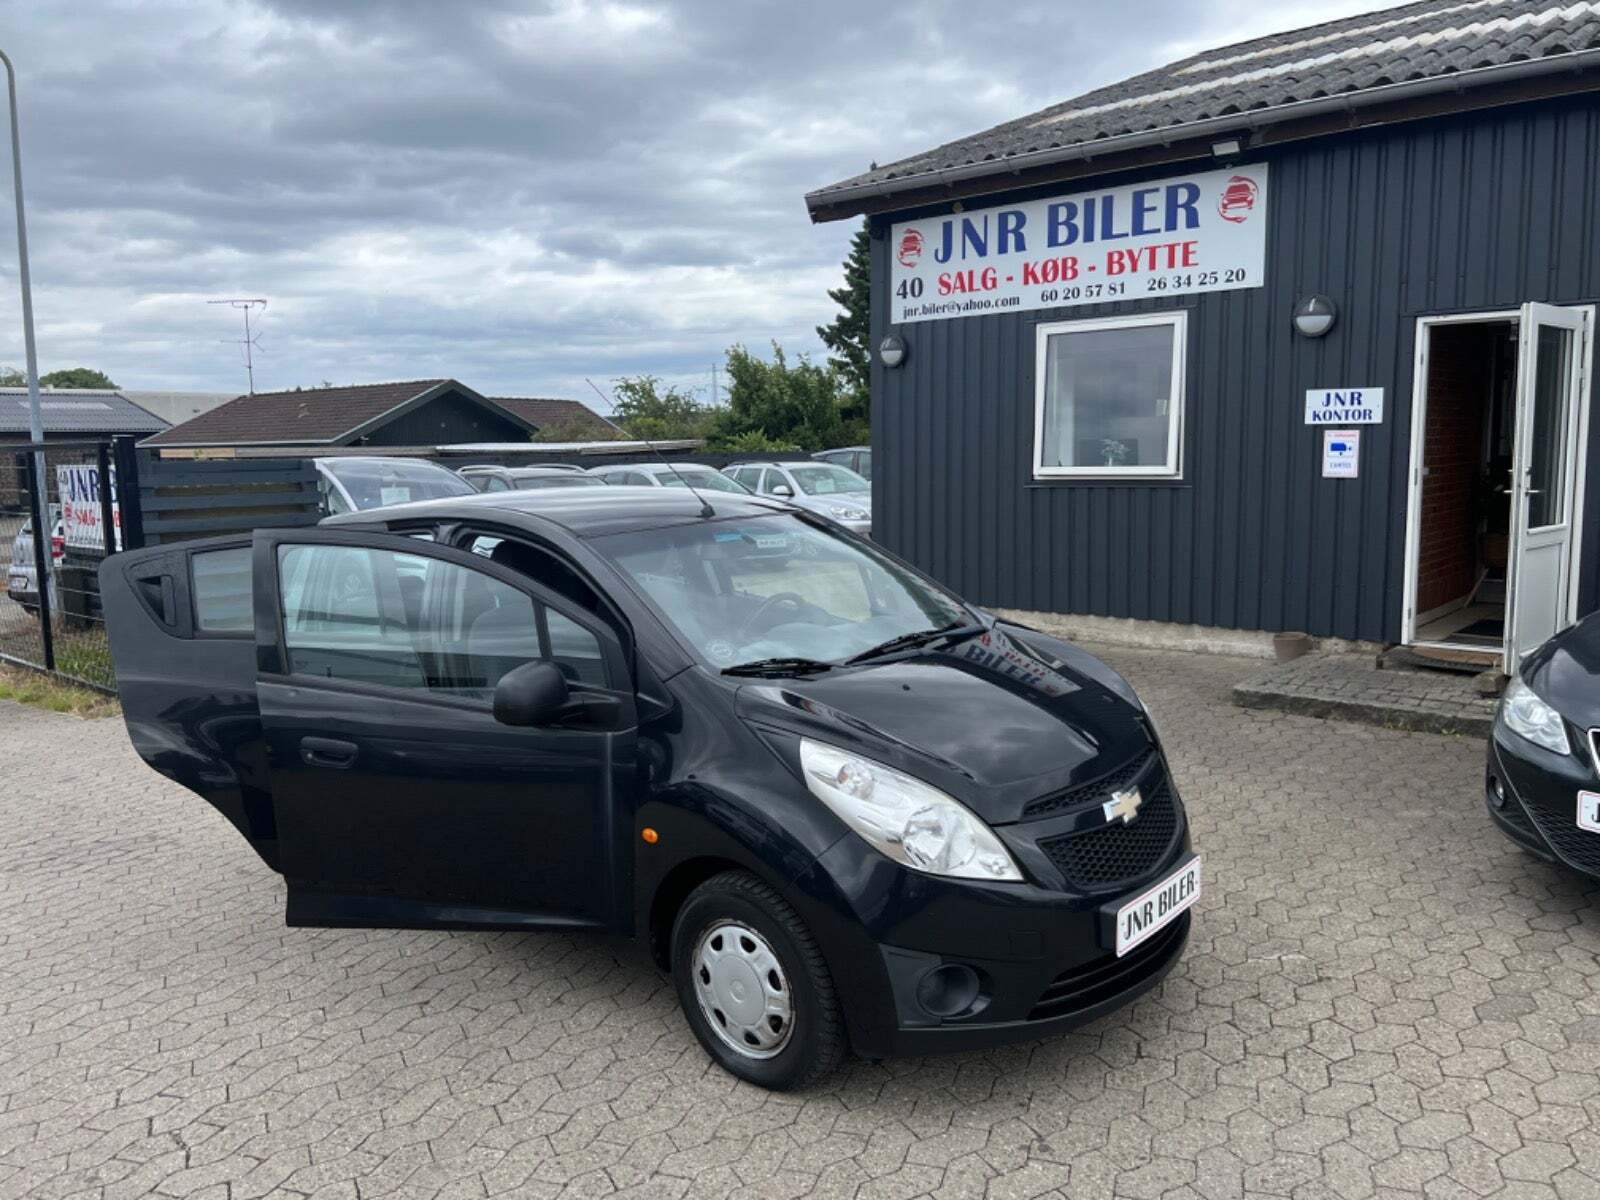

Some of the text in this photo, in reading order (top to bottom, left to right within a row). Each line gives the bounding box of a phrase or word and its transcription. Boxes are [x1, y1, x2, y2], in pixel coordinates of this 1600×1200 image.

[934, 182, 1201, 263] JNR BILER
[938, 267, 997, 296] SALG
[1023, 256, 1079, 285] KØB
[1106, 241, 1200, 276] BYTTE
[1147, 268, 1246, 291] 26 34 25 20
[896, 277, 924, 299] 40
[1041, 281, 1125, 302] 60 20 57 81
[903, 296, 1020, 319] jnr.biler@yahoo.com
[1322, 391, 1362, 407] JNR
[1312, 408, 1373, 422] KONTOR
[69, 469, 100, 502] JNR
[1124, 870, 1195, 941] JNR BILER
